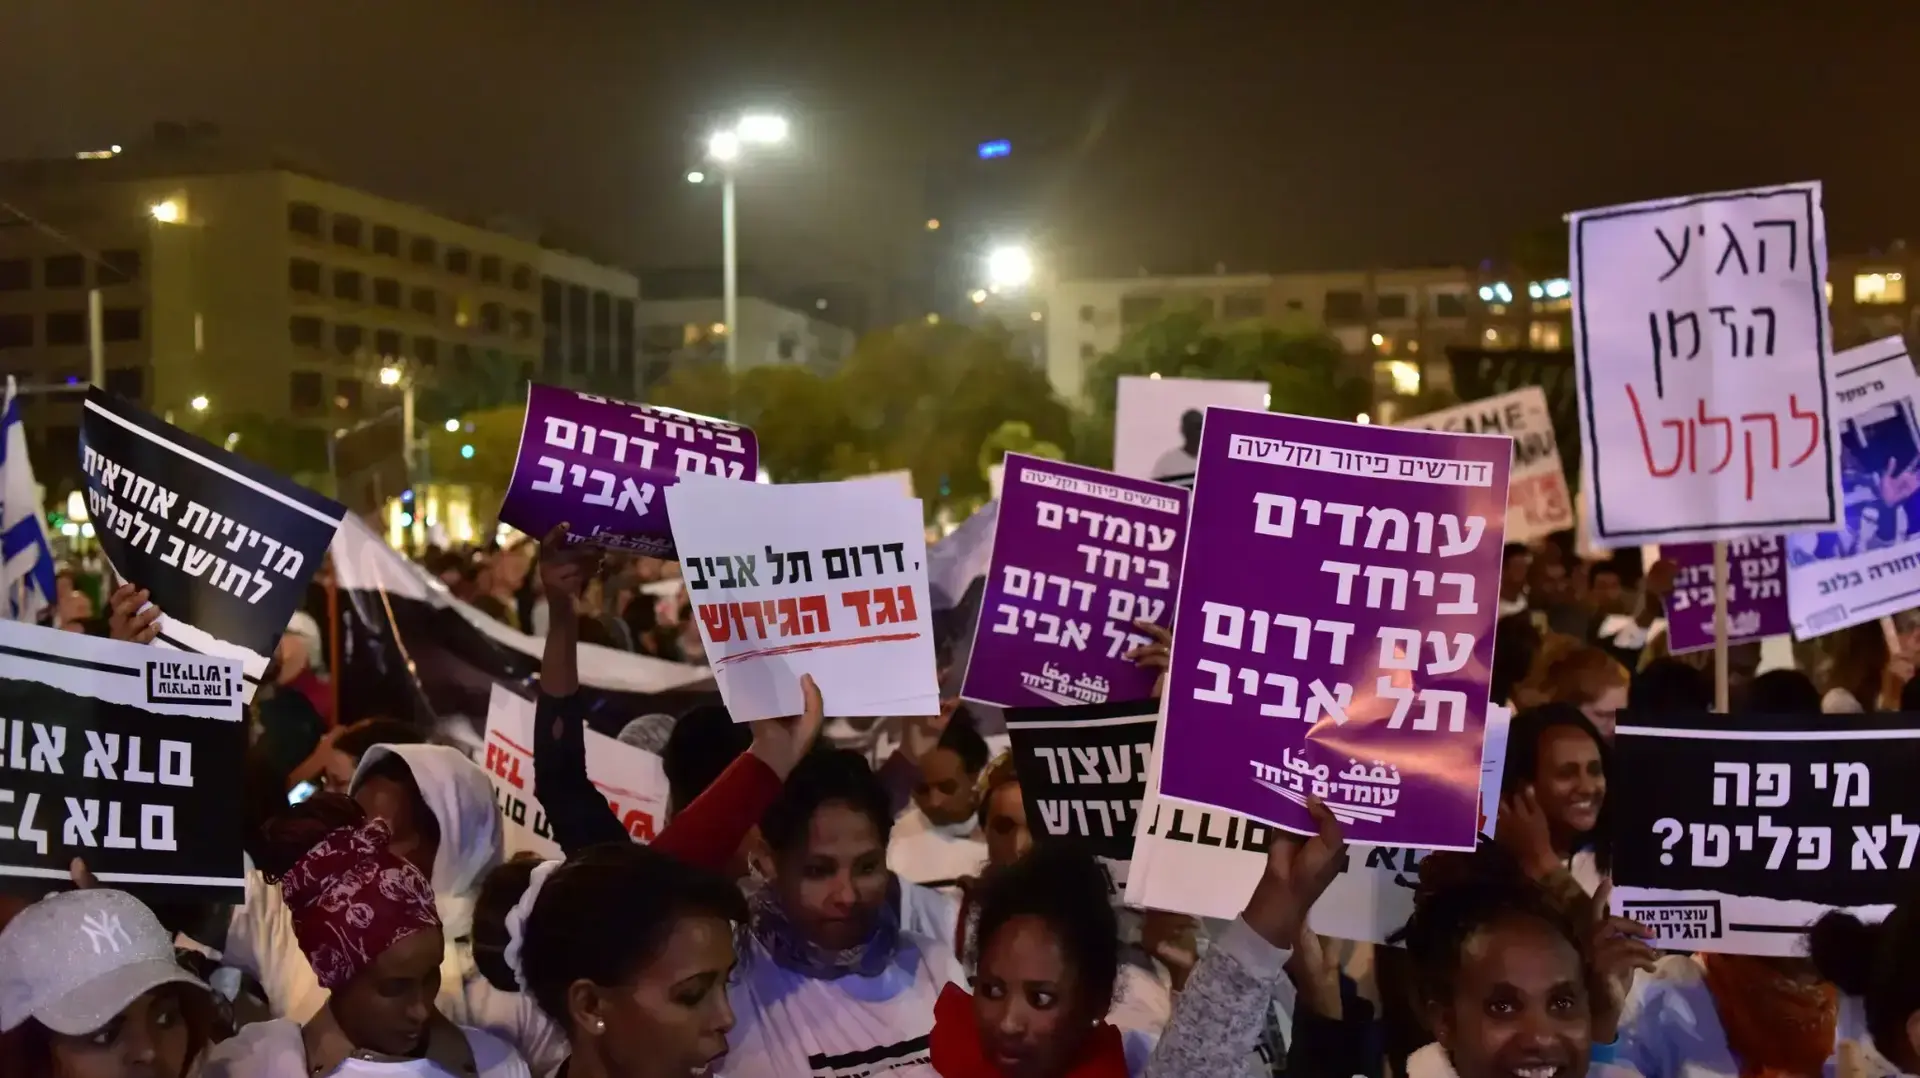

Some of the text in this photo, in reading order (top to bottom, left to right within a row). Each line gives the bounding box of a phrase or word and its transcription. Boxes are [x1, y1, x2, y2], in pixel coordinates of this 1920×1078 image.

[1655, 219, 1796, 281] הגיע
[1650, 306, 1776, 399] הזמן
[544, 416, 659, 470] דרום
[1237, 437, 1488, 483] דורשים פיזור וקליטה
[1625, 383, 1819, 501] לקלוט
[83, 444, 305, 580] מדיניות אחראית
[531, 455, 655, 516] אביב
[1025, 469, 1177, 510] דורשים פיזור וקליטה
[88, 486, 273, 604] לתושב ולפליט
[1036, 501, 1176, 551] עומדים
[1252, 491, 1487, 557] עומדים
[686, 543, 905, 590] דרום תל אביב
[1077, 544, 1170, 589] ביחד
[1320, 560, 1479, 615] ביחד
[1743, 578, 1785, 605] תל
[699, 585, 917, 643] נגד הגירוש
[1003, 565, 1165, 624] עם דרום
[992, 604, 1092, 651] אביב
[1201, 600, 1476, 676] עם דרום
[203, 683, 222, 696] את
[1021, 671, 1108, 703] עומדים ביחד
[1193, 658, 1468, 732] תל אביב
[83, 729, 194, 787] אדם
[485, 742, 524, 790] נגד
[1250, 760, 1400, 806] עומדים ביחד
[1713, 762, 1870, 807] מי פה
[63, 796, 177, 851] אדם
[1652, 814, 1920, 870] לא פליט?
[1635, 909, 1708, 921] עוצרים את
[1650, 923, 1707, 939] הגירו
